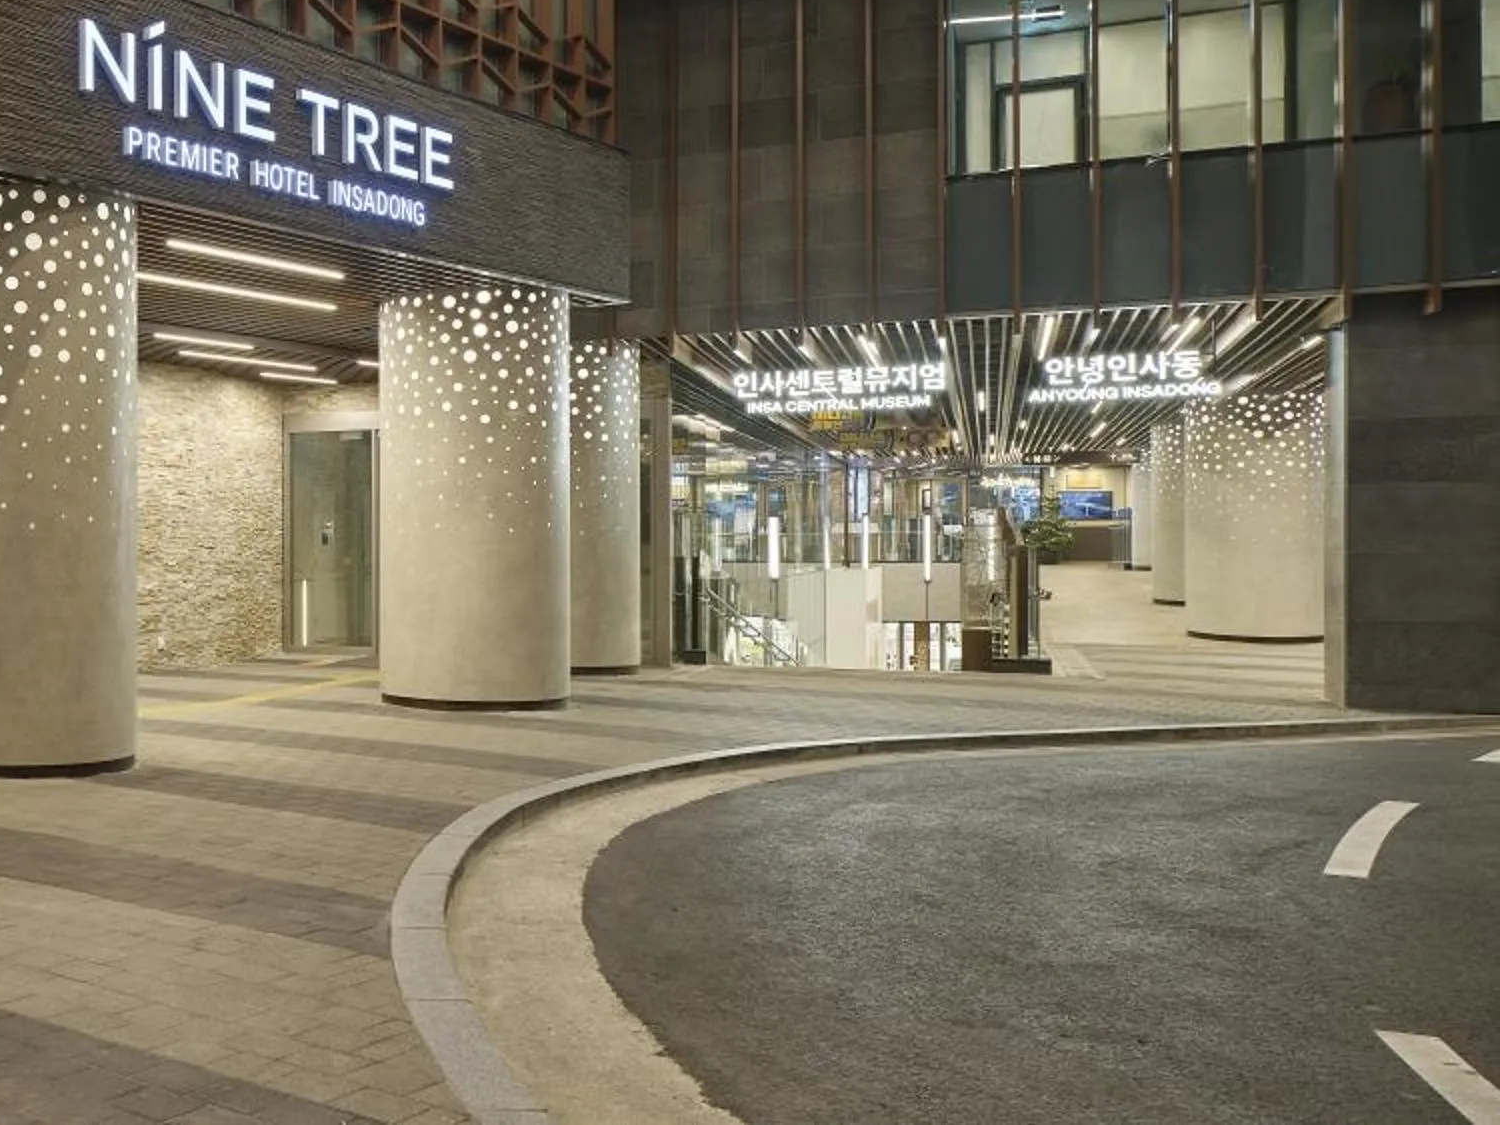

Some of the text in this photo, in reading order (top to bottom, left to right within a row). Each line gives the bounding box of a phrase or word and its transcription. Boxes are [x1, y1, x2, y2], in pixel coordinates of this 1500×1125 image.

[296, 88, 455, 190] TREE
[123, 126, 426, 227] PREMIER HOTEL INSADONG
[733, 362, 946, 399] 인사센트럴뮤지엄
[1044, 350, 1202, 385] 안녕인사동
[747, 394, 931, 414] INSA CENTRAL MUSEUM
[1028, 381, 1223, 402] ANYOUNG INSADONG
